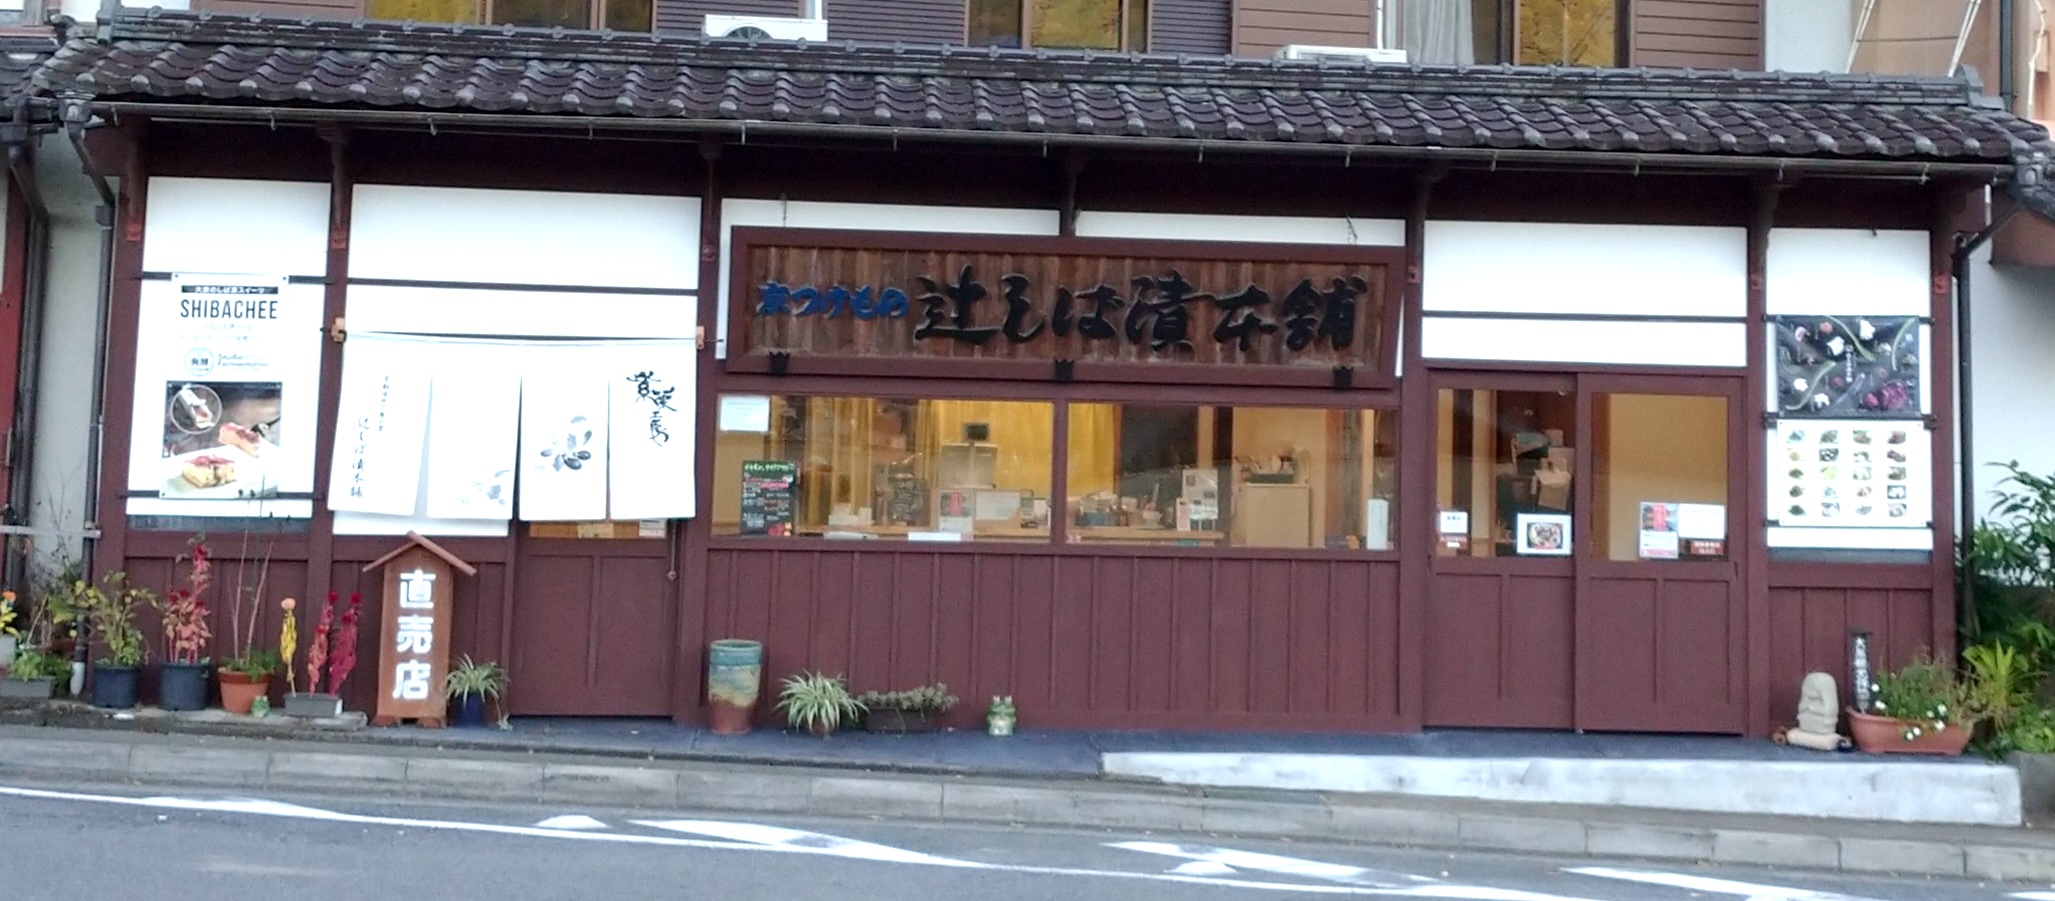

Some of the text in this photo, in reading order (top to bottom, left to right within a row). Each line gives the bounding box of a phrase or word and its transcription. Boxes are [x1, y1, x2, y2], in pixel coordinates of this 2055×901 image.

[181, 299, 278, 319] SHIBACHEE
[392, 569, 436, 700] 直売店
